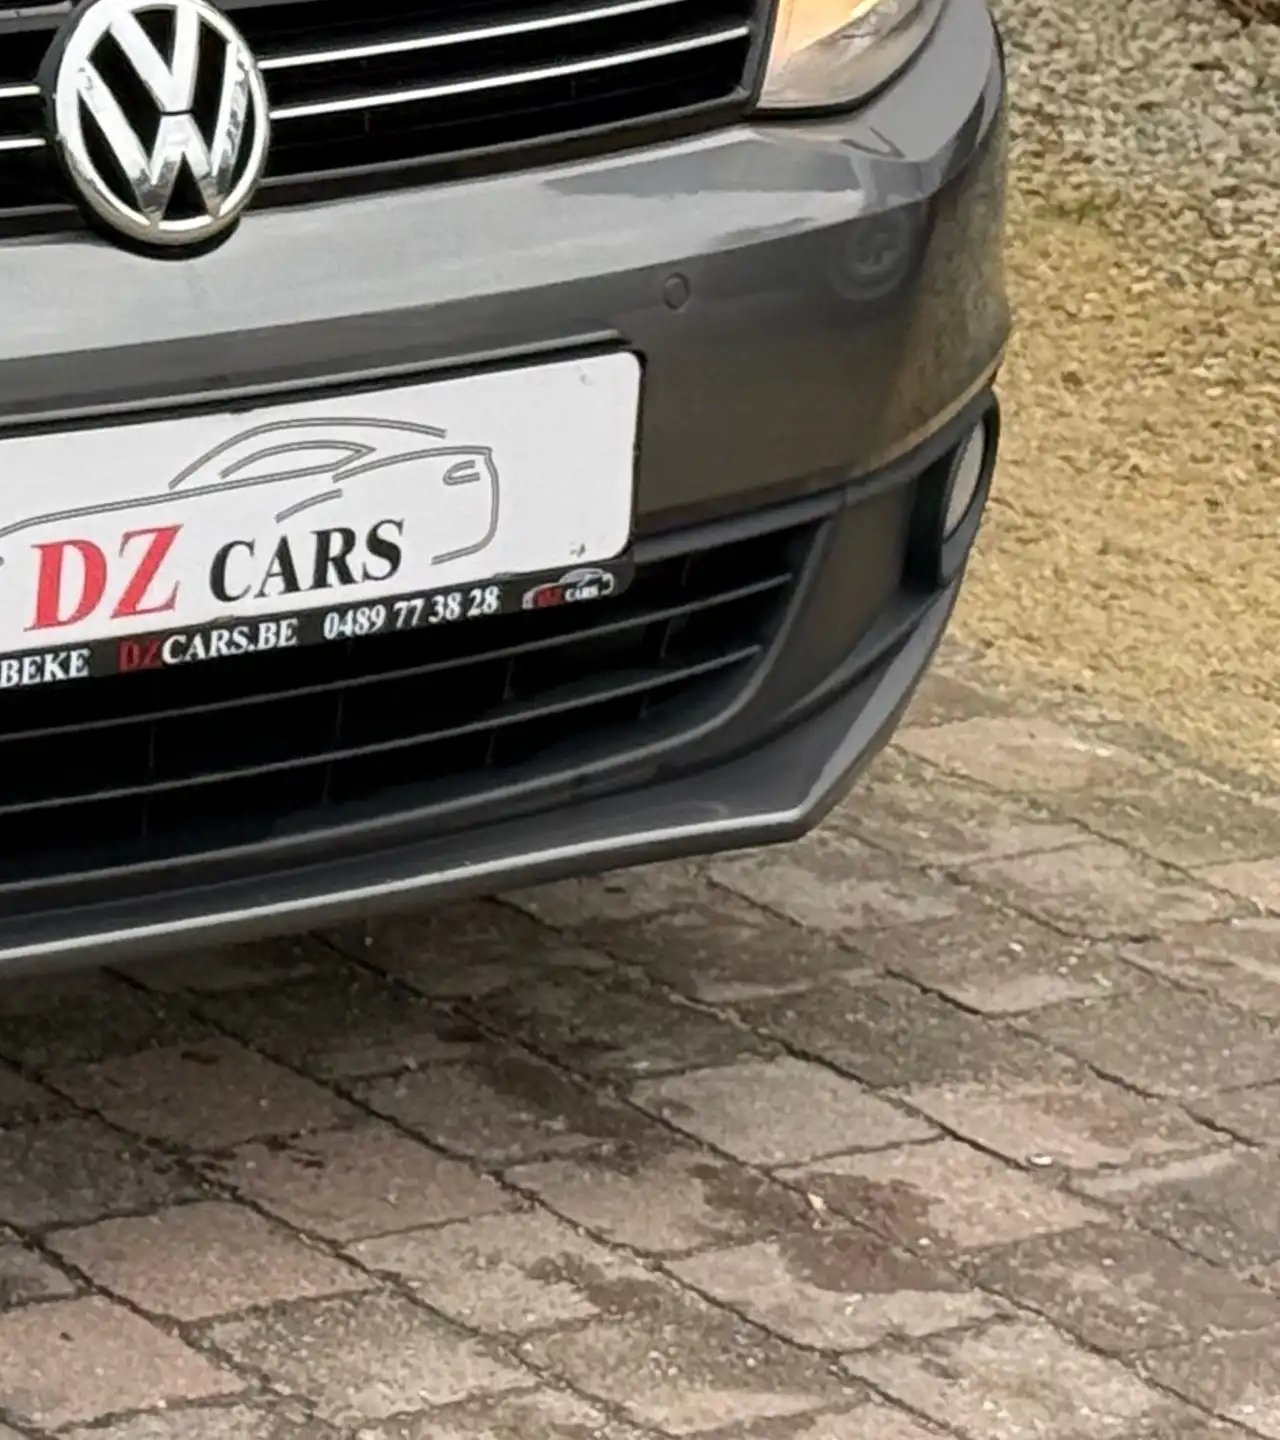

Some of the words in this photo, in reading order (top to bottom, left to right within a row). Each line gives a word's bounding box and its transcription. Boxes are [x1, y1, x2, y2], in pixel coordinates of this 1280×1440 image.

[23, 524, 184, 633] DZ
[209, 518, 405, 603] CARS
[323, 604, 387, 641] 0489
[392, 597, 425, 630] 77
[428, 591, 462, 624] 38
[466, 585, 500, 618] 28
